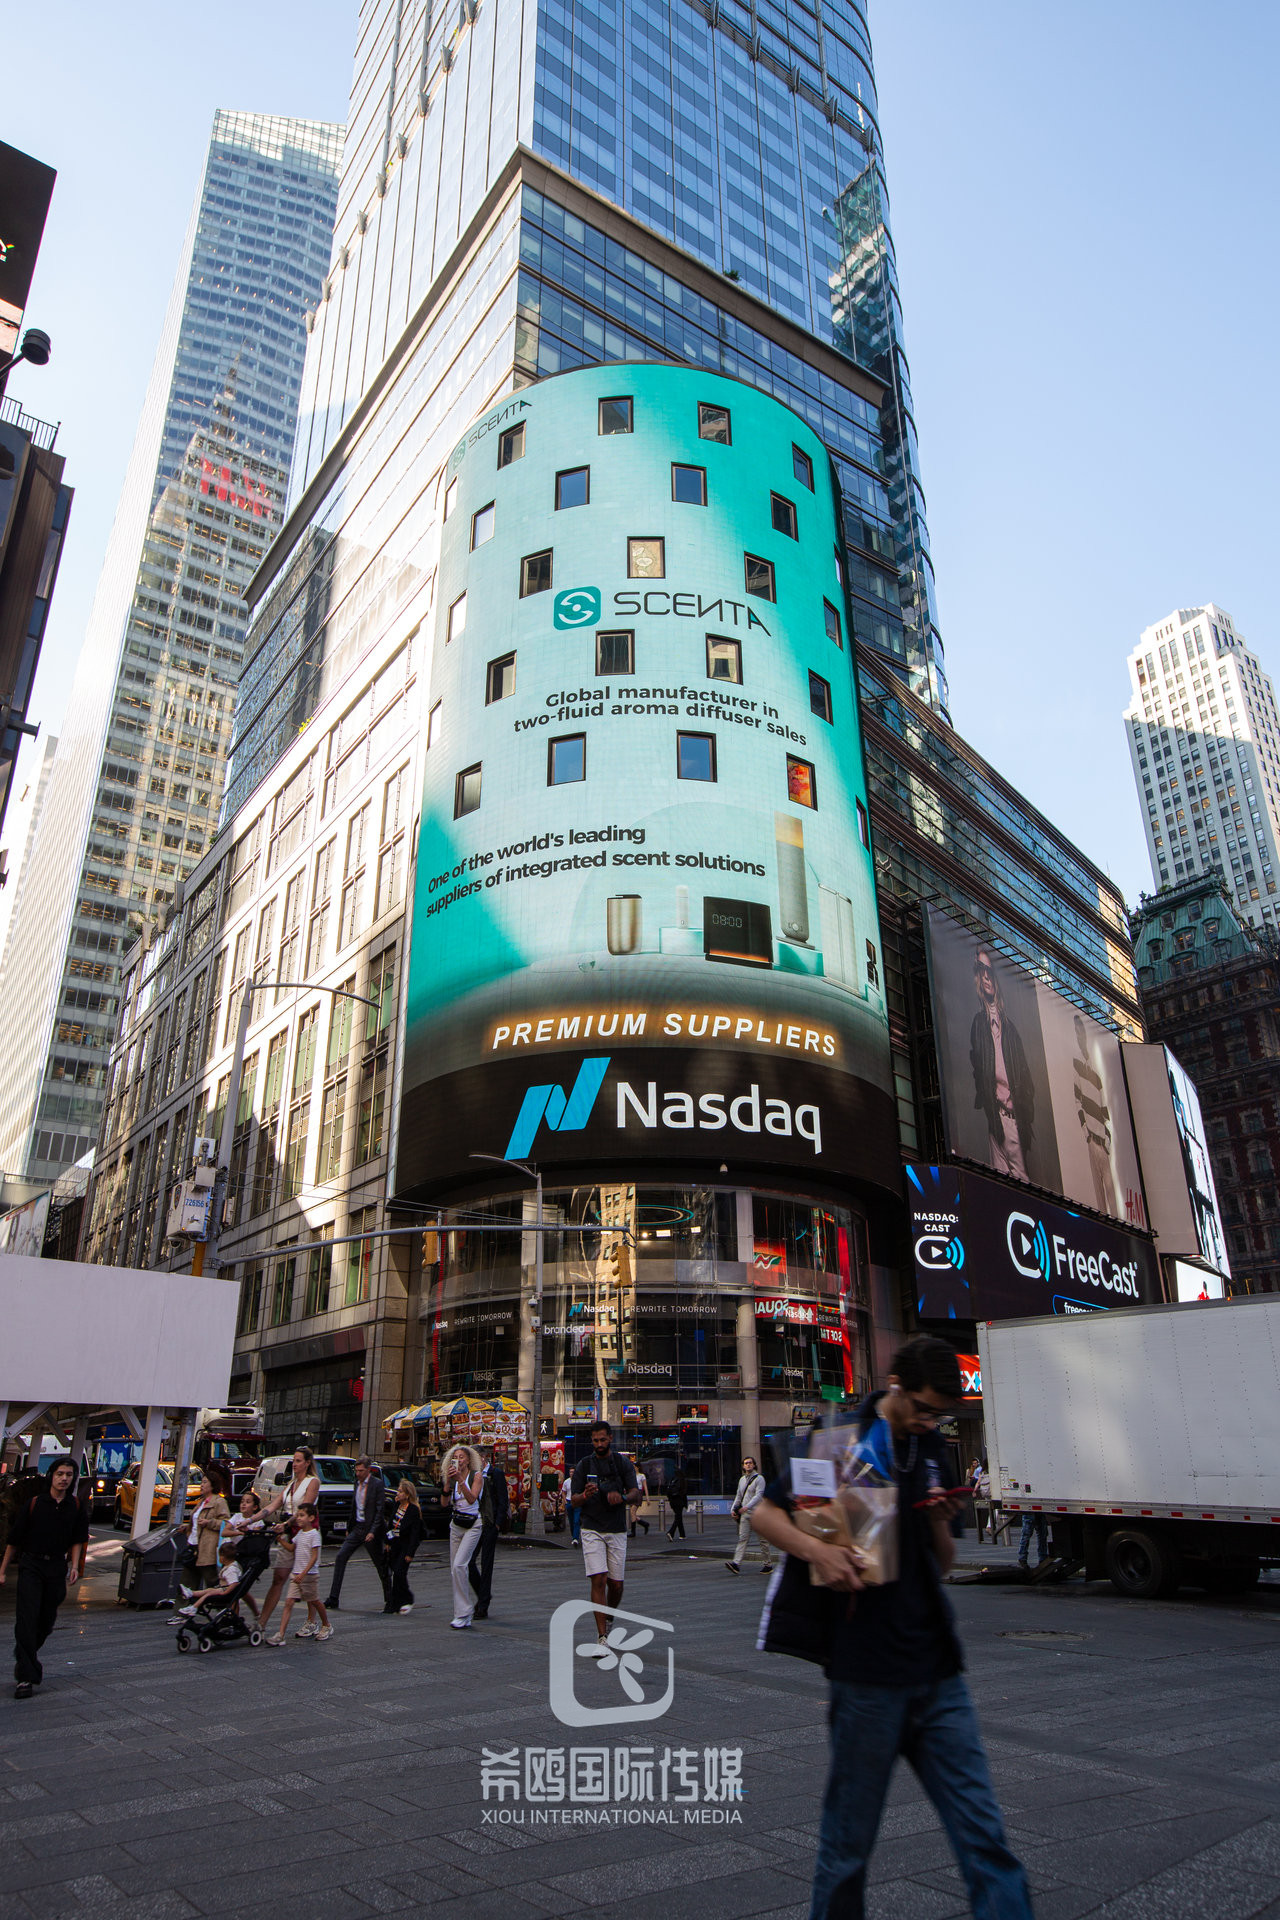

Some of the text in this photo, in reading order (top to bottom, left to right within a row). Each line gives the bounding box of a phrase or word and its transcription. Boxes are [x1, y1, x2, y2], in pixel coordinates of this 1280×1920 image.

[514, 702, 807, 746] two-fluid aroma diffuser sales
[545, 686, 779, 720] Global manufacturer in
[428, 825, 646, 894] One of the world's leading
[426, 851, 766, 918] suppliers of integrated scent solutions
[492, 1013, 836, 1057] PREMIUM SUPPLIERS
[617, 1082, 823, 1155] Nasdaq
[914, 1213, 959, 1223] NASDAQ:
[925, 1224, 950, 1232] CAST
[1053, 1235, 1139, 1298] FreeCast
[584, 1305, 718, 1314] Nasdaq REWRITE TOMORROW
[628, 1363, 672, 1376] Nasdaq
